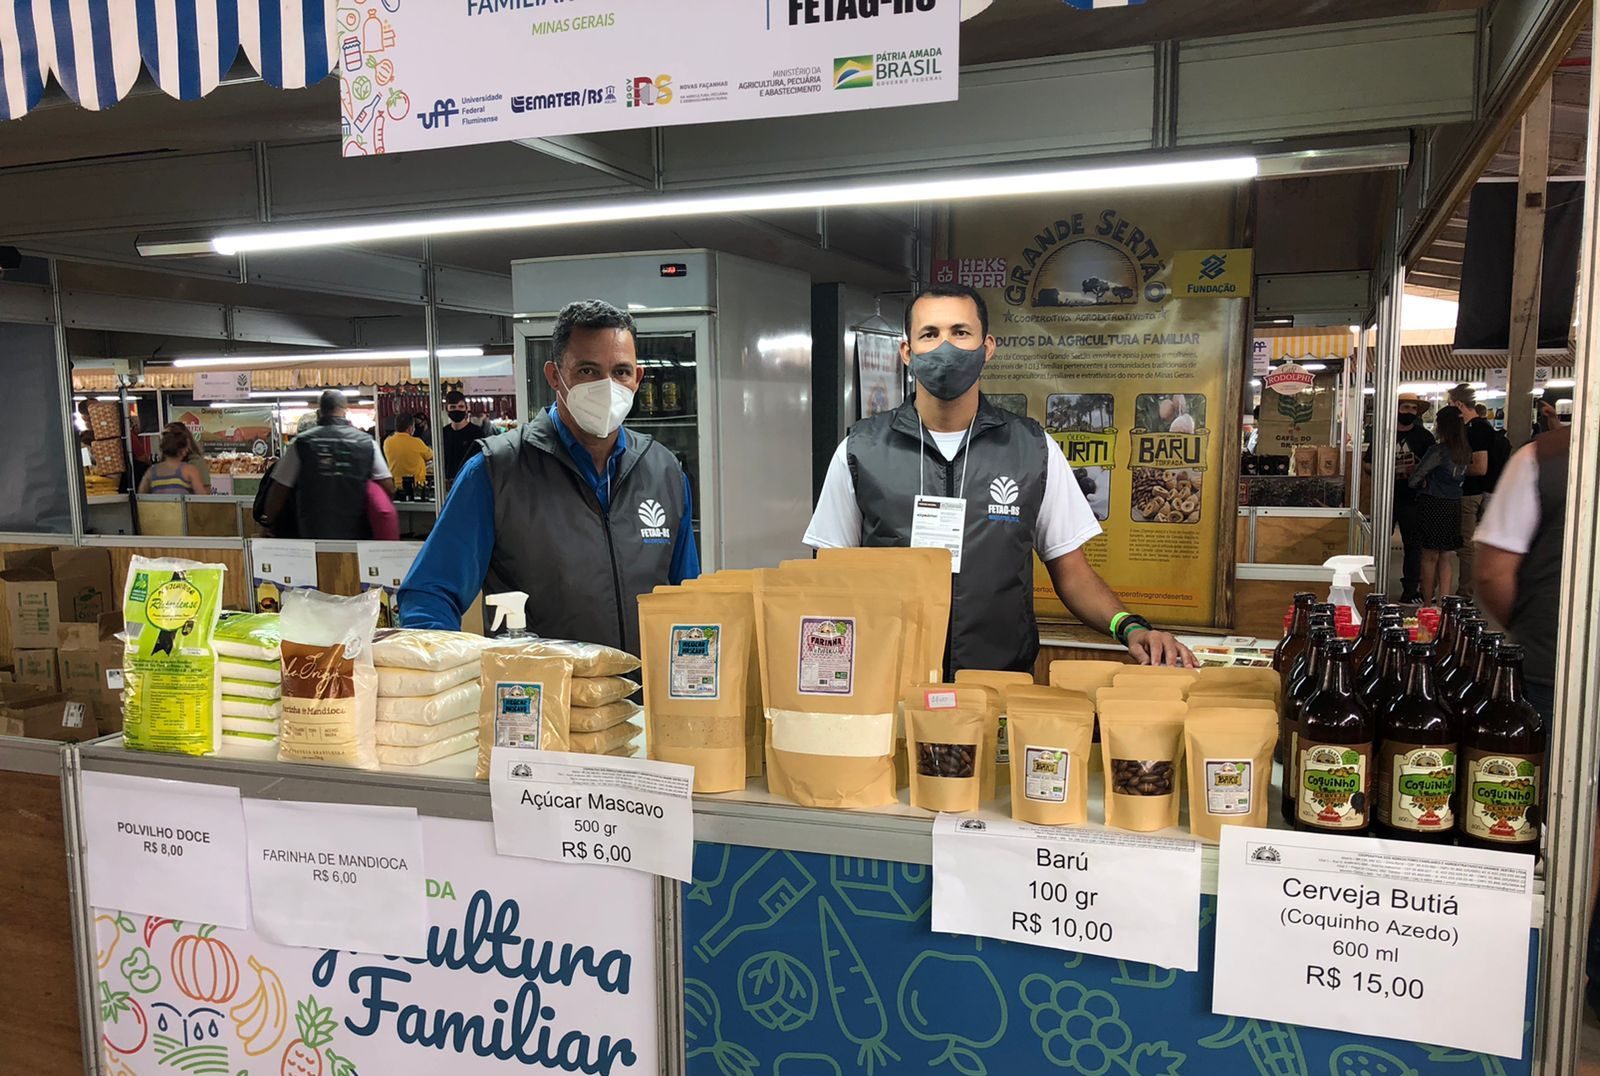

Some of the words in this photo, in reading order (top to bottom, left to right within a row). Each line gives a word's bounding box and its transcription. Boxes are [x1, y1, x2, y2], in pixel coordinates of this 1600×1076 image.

[531, 18, 570, 36] MINAS
[572, 12, 615, 30] GERAIS
[876, 50, 907, 62] PÁTRIA
[908, 47, 942, 60] AMADA
[772, 67, 811, 78] MINISTÉRIO
[811, 66, 822, 75] DA
[876, 58, 942, 80] BRASIL
[679, 83, 698, 91] NOVAS
[699, 81, 728, 90] FAÇANHAS
[738, 78, 787, 90] AGRICULTURA,
[787, 75, 821, 85] PECUÁRIA
[876, 78, 909, 87] GOVERNO
[911, 75, 942, 83] FEDERAL
[461, 93, 503, 105] Universidade
[759, 89, 764, 97] E
[765, 85, 822, 97] ABASTECIMENTO
[461, 105, 485, 115] Federal
[462, 115, 498, 125] Fluminense
[960, 257, 1008, 273] HEKS
[1003, 213, 1085, 306] GRANDE
[960, 273, 1006, 288] EPER
[995, 335, 1035, 348] DUTOS
[1038, 335, 1054, 347] DA
[1057, 333, 1140, 347] AGRICULTURA
[1143, 332, 1201, 345] FAMILIAR
[1047, 352, 1070, 360] Grande
[1014, 362, 1023, 370] de
[1109, 361, 1151, 369] comunidades
[1268, 373, 1310, 384] RODOLPHI
[1300, 434, 1312, 442] DO
[1056, 440, 1108, 463] URITI
[1138, 437, 1200, 464] BARU
[987, 504, 1020, 516] FETAG-RS
[810, 636, 842, 647] FARINHA
[520, 789, 582, 811] Açúcar
[588, 793, 664, 819] Mascavo
[117, 821, 174, 840] POLVILHO
[176, 828, 211, 844] DOCE
[574, 819, 600, 833] 500
[603, 822, 618, 837] gr
[143, 841, 158, 855] R$
[160, 843, 183, 857] 8,00
[562, 841, 588, 860] R$
[593, 843, 632, 864] 6,00
[263, 849, 316, 865] FARINHA
[318, 852, 336, 866] DE
[338, 854, 409, 871] MANDIOCA
[1036, 847, 1089, 871] Barú
[313, 868, 330, 883] R$
[332, 870, 357, 885] 6,00
[425, 878, 457, 901] DA
[1029, 880, 1068, 903] 100
[1075, 889, 1098, 911] gr
[1282, 877, 1380, 910] Cerveja
[1391, 887, 1459, 916] Butiá
[1012, 911, 1043, 935] R$
[1051, 916, 1113, 943] 10,00
[1279, 907, 1380, 933] (Coquinho
[1385, 919, 1459, 947] Azedo)
[1332, 940, 1369, 959] 600
[1376, 947, 1399, 963] ml
[1305, 965, 1342, 991] R$
[1352, 970, 1425, 1000] 15,00
[344, 965, 637, 1076] Familiar
